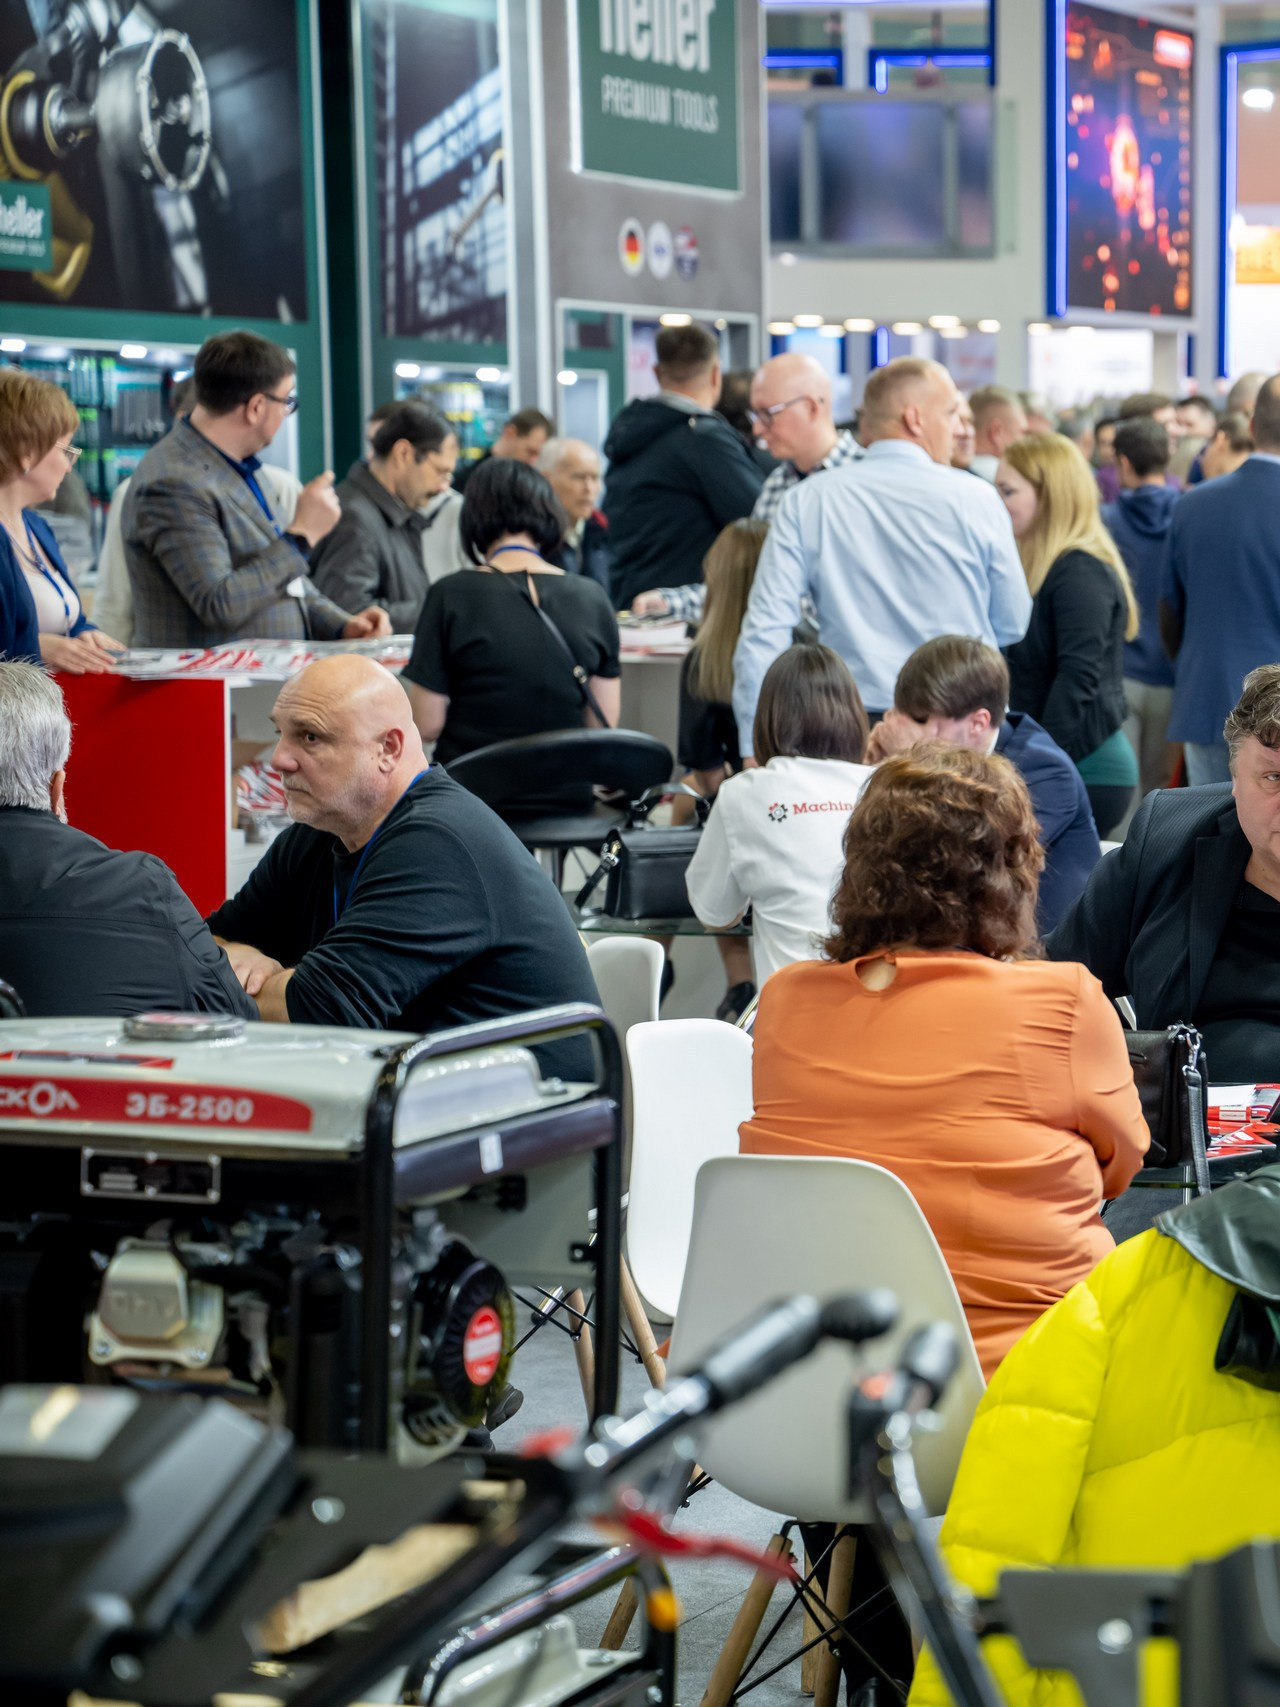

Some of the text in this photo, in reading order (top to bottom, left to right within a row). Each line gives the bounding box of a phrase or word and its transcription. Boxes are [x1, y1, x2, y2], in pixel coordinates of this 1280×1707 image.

[601, 75, 719, 134] PREMIUM TOOLS
[792, 801, 854, 815] Machin
[125, 1092, 254, 1123] ЭБ-2500
